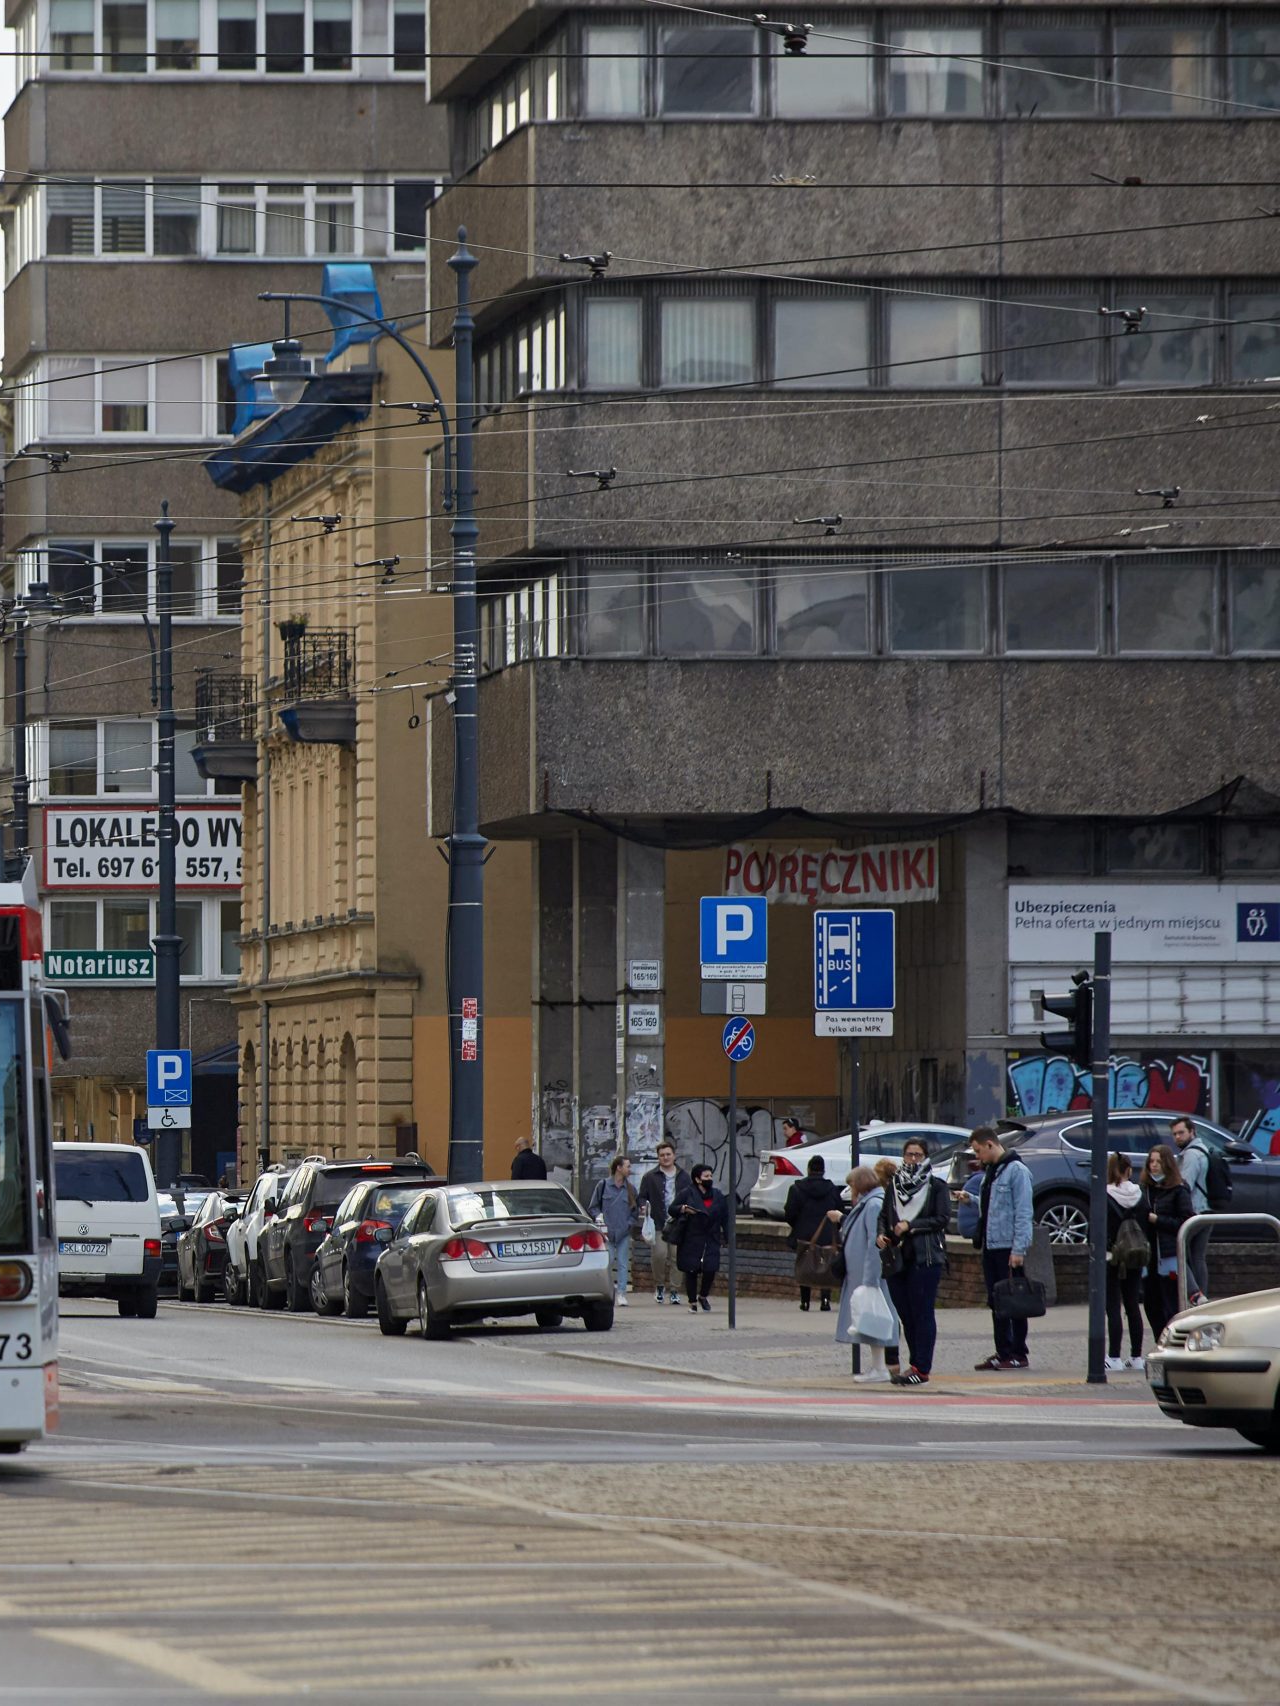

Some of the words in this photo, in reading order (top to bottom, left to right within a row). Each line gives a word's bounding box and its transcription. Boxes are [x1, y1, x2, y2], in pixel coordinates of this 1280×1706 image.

[55, 817, 156, 848] LOKALE
[53, 857, 90, 878] Tel.
[97, 857, 135, 878] 697
[185, 857, 229, 882] 557,
[1015, 900, 1116, 915] Ubezpieczenia
[716, 904, 754, 956] P
[1015, 916, 1052, 929] Pełna
[1055, 916, 1095, 929] oferta
[1099, 920, 1110, 929] w
[1113, 916, 1165, 931] jednym
[1168, 917, 1221, 931] miejscu
[48, 955, 150, 975] Notariusz
[828, 959, 851, 971] BUS
[829, 1026, 847, 1034] tylko
[157, 1055, 182, 1090] P
[64, 1243, 79, 1253] SKL
[81, 1244, 106, 1253] 00722
[504, 1243, 519, 1255] EL
[521, 1241, 552, 1253] 9158Y
